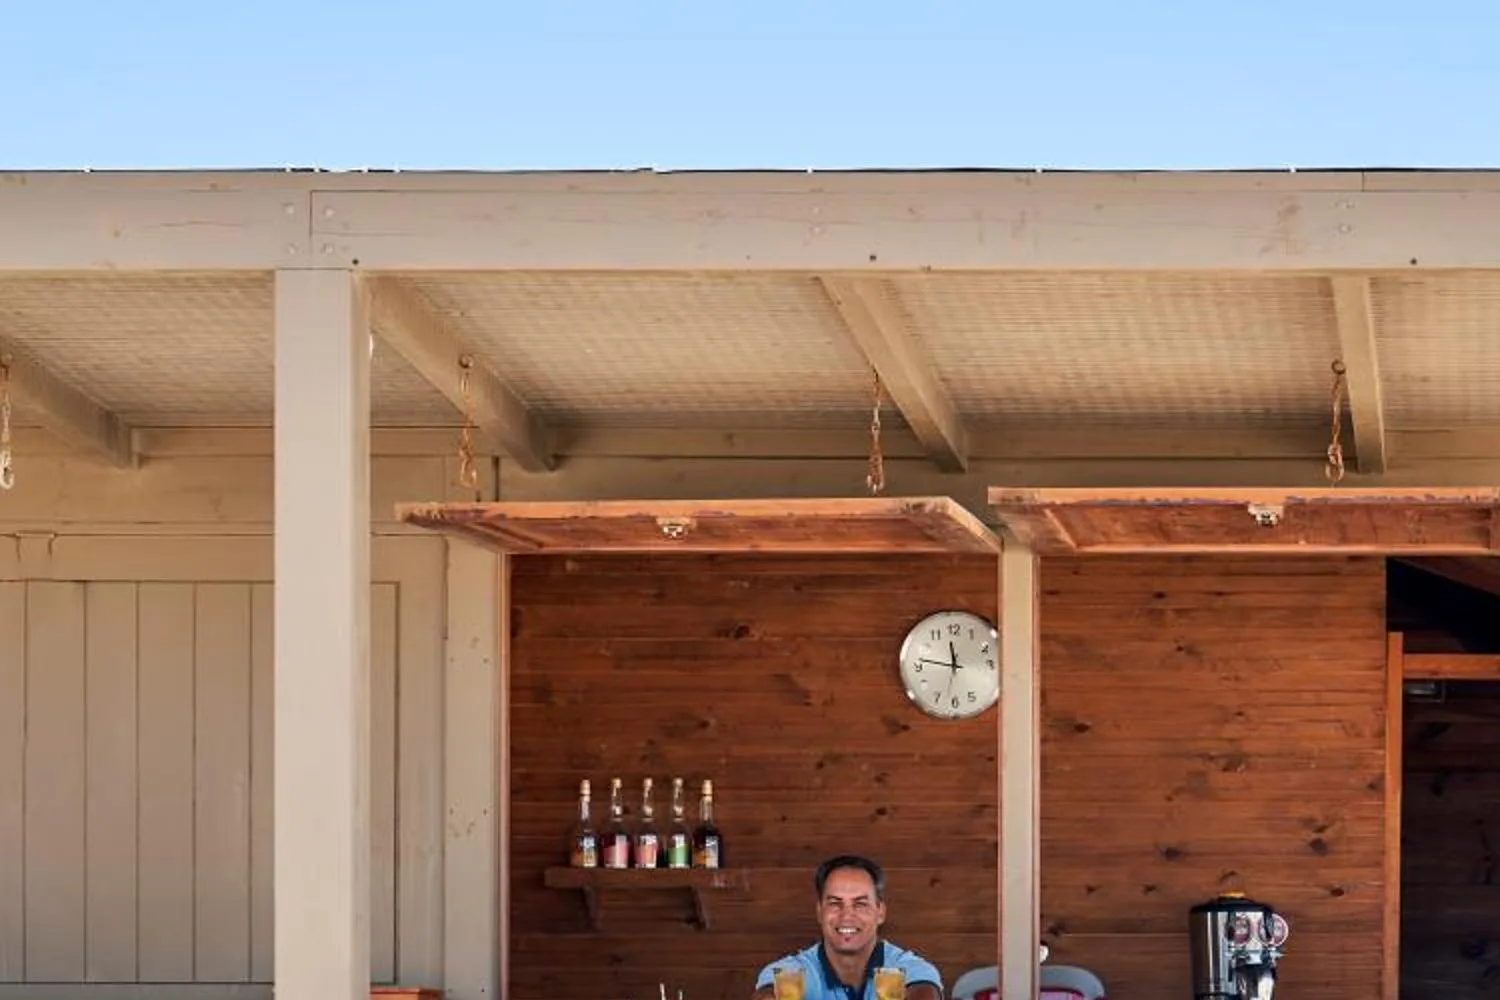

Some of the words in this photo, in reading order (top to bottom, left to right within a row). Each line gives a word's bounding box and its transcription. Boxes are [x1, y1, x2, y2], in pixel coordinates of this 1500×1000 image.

[931, 629, 941, 641] 11
[947, 624, 961, 636] 12
[967, 691, 977, 702] 5
[951, 697, 960, 709] 6
